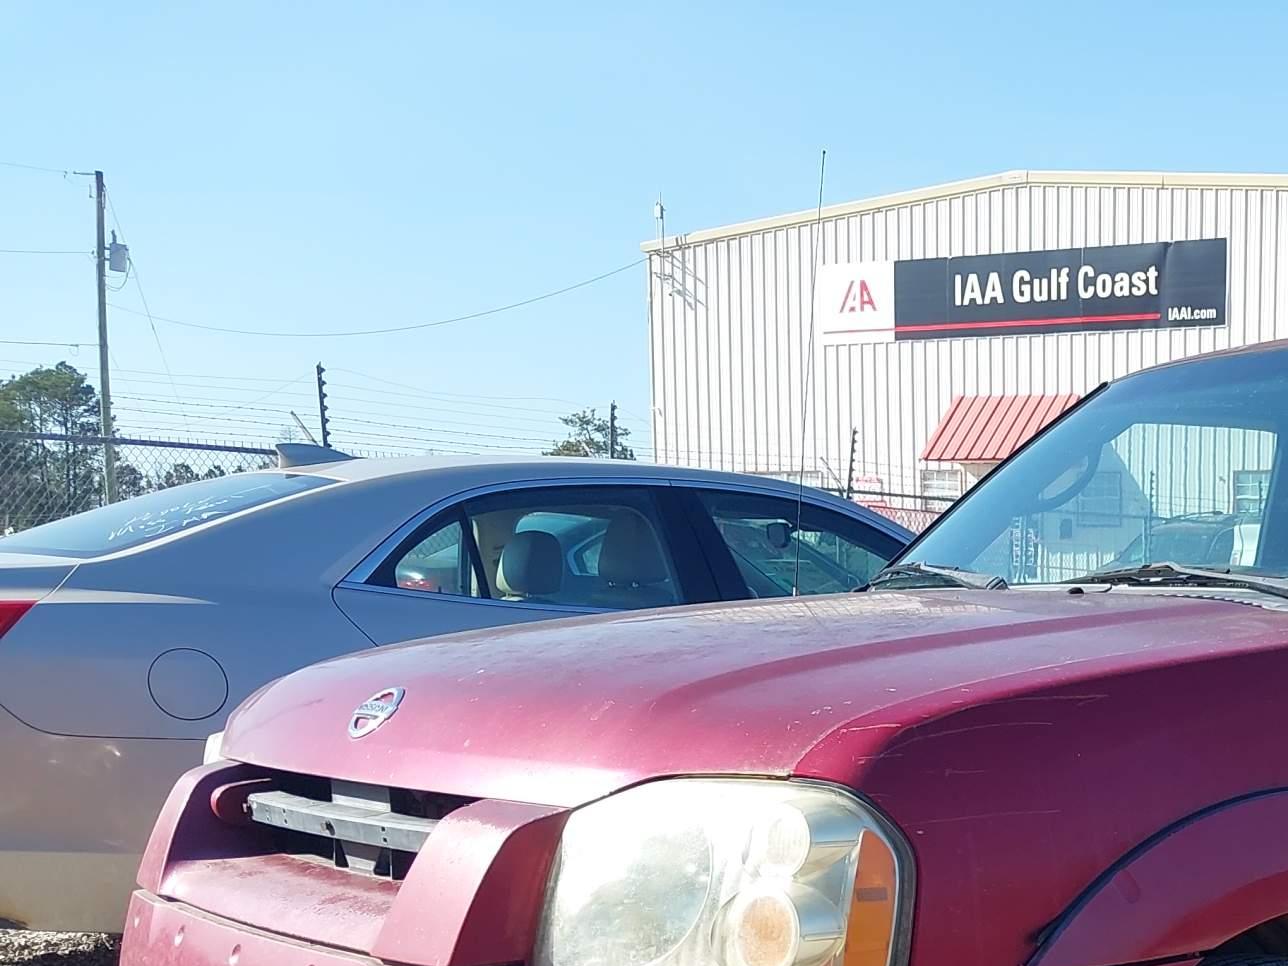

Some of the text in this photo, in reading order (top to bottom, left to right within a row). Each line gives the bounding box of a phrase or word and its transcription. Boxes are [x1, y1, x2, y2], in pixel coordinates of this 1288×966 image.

[954, 264, 1159, 306] IAA Gulf Coast
[1167, 306, 1217, 322] IAAI.com
